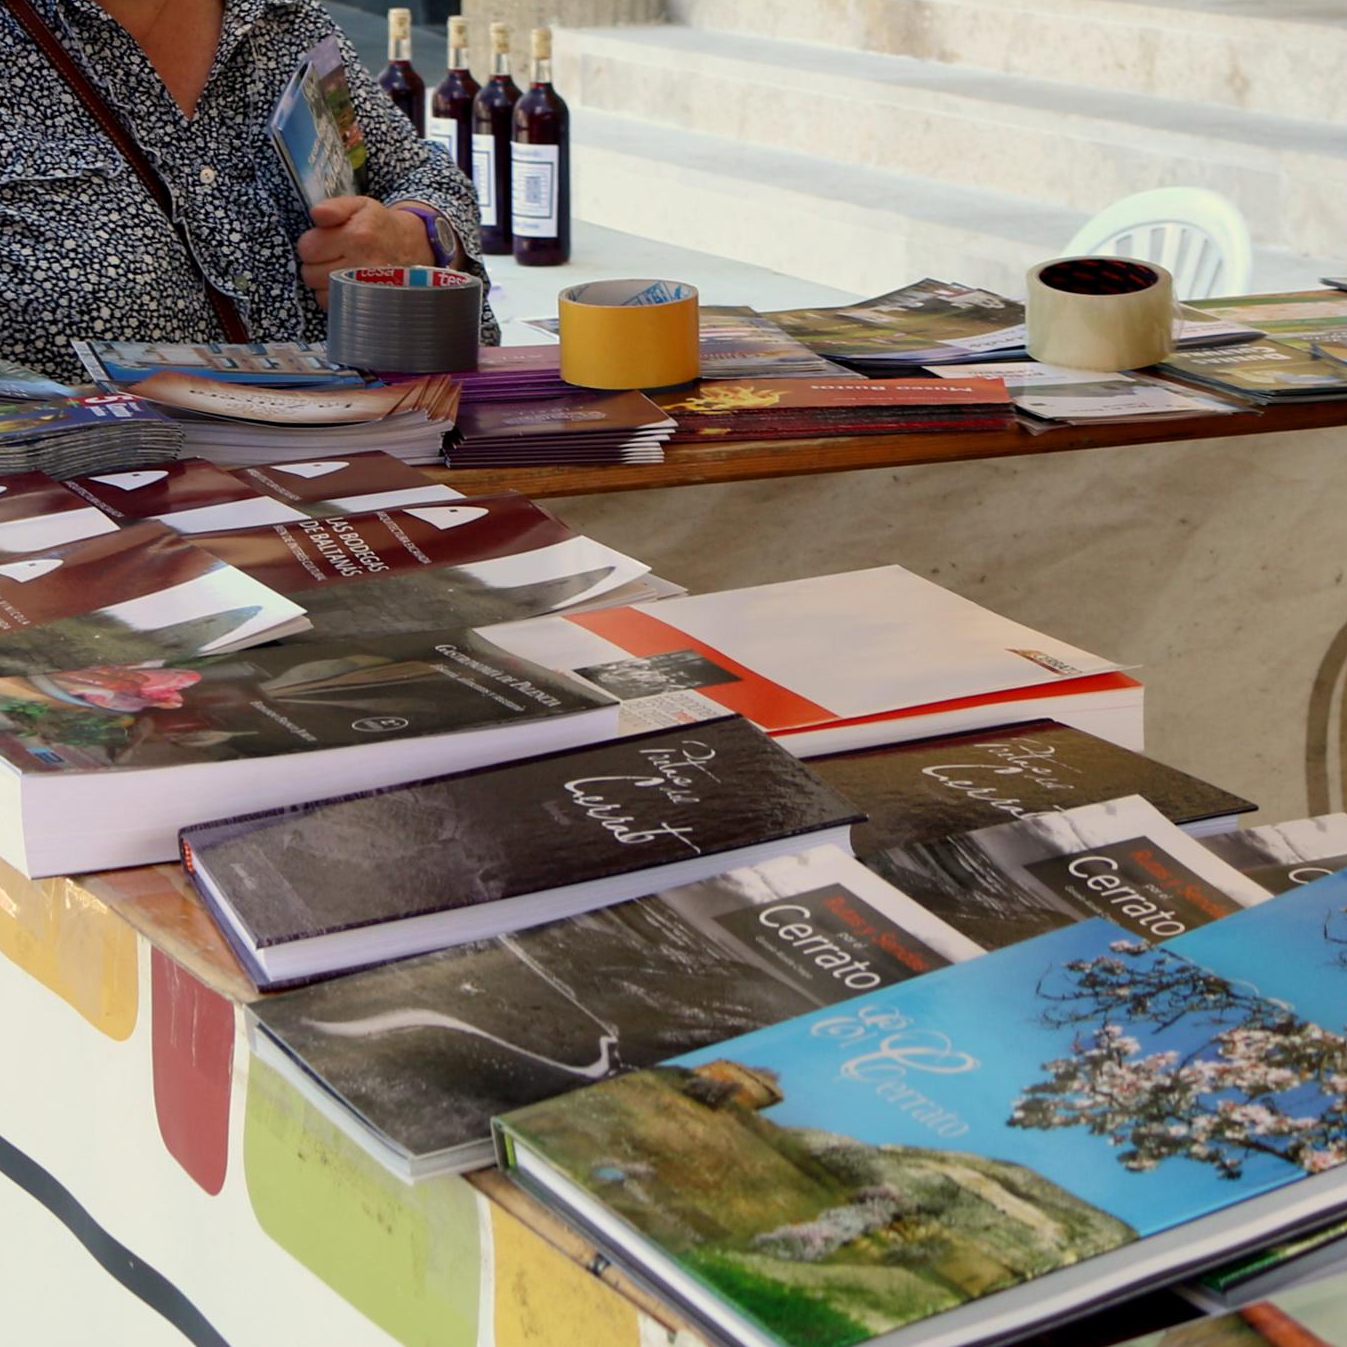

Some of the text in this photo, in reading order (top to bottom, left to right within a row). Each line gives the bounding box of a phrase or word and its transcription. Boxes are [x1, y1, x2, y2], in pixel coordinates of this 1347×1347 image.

[299, 520, 364, 577] DE BALTANÁS
[325, 517, 390, 573] LAS BODEGAS
[1068, 855, 1187, 937] Cerrato
[759, 904, 881, 990] Cerrato
[838, 1028, 982, 1138] Cerrato
